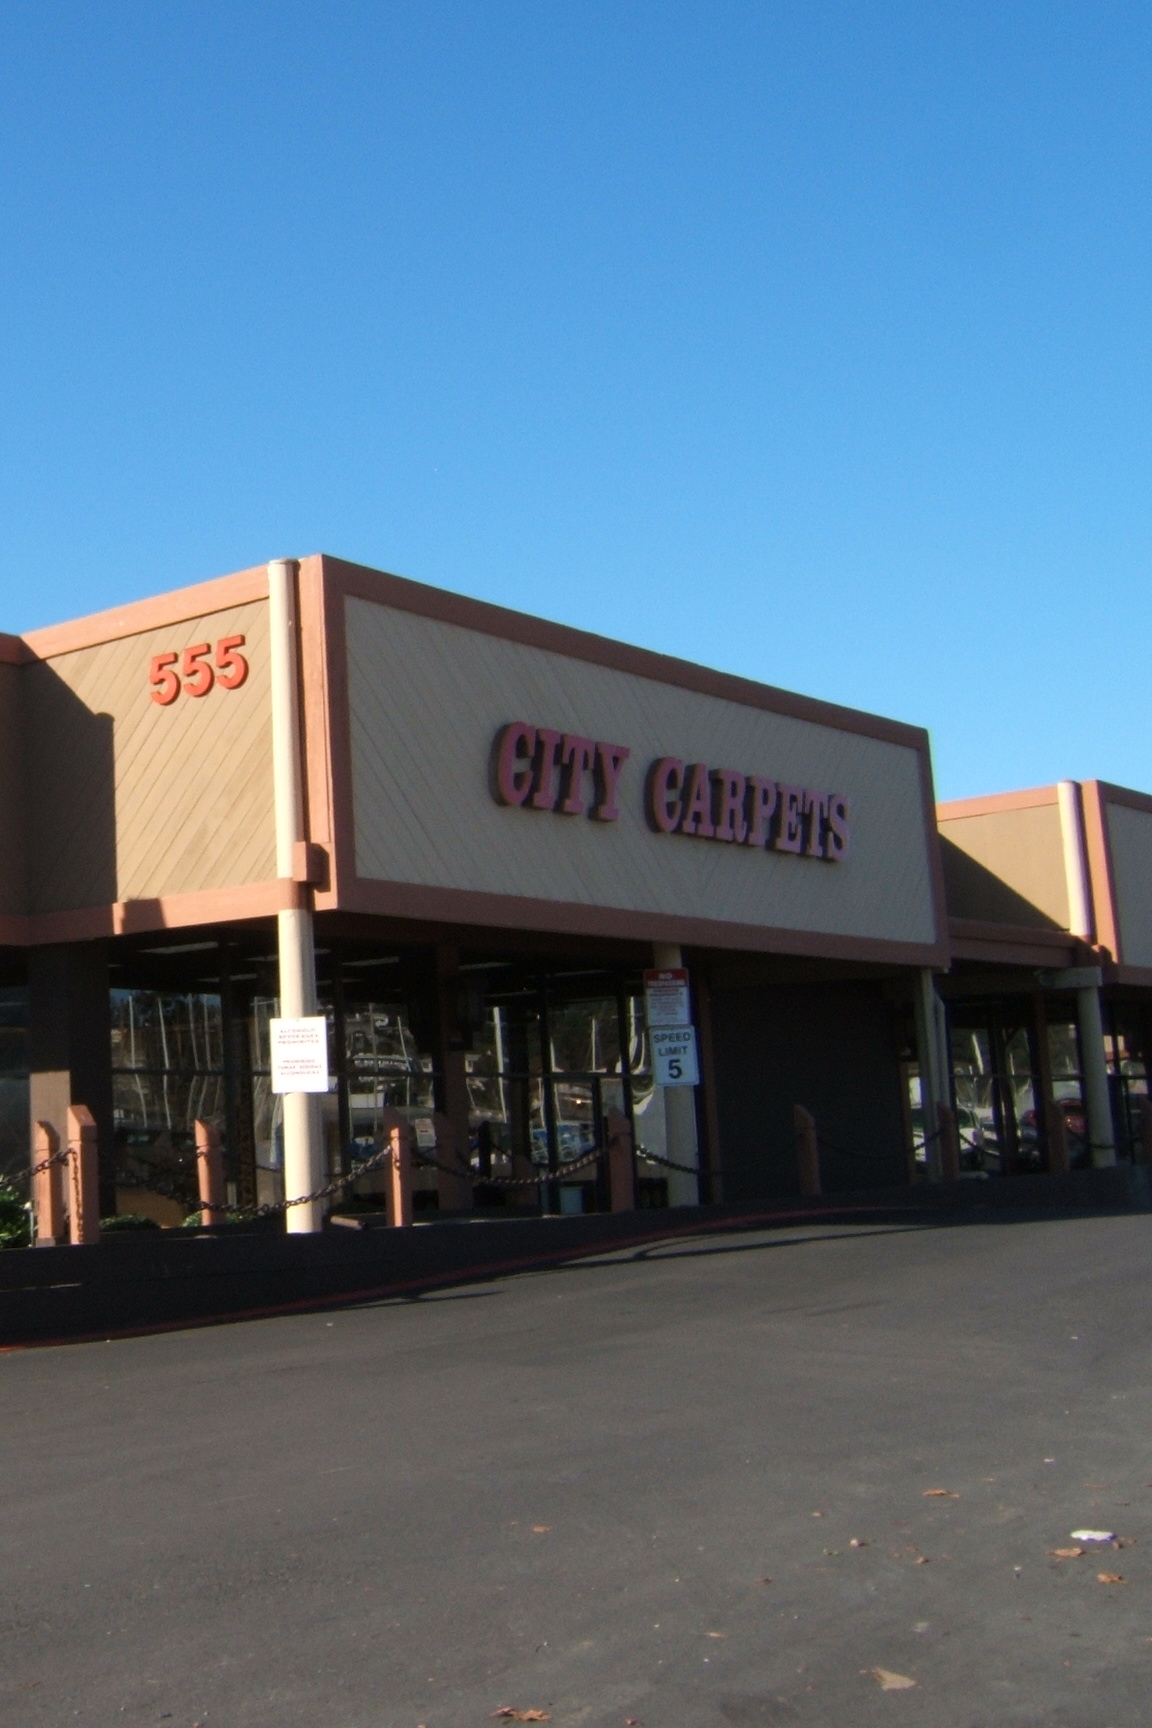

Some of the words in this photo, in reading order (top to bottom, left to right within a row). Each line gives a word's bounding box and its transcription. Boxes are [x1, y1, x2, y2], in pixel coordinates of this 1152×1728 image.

[149, 634, 249, 706] 555
[489, 720, 630, 821] CITY
[645, 756, 849, 863] CARPETS
[653, 1031, 691, 1043] SPEED
[658, 1046, 688, 1056] LIMIT
[668, 1058, 682, 1079] 5
